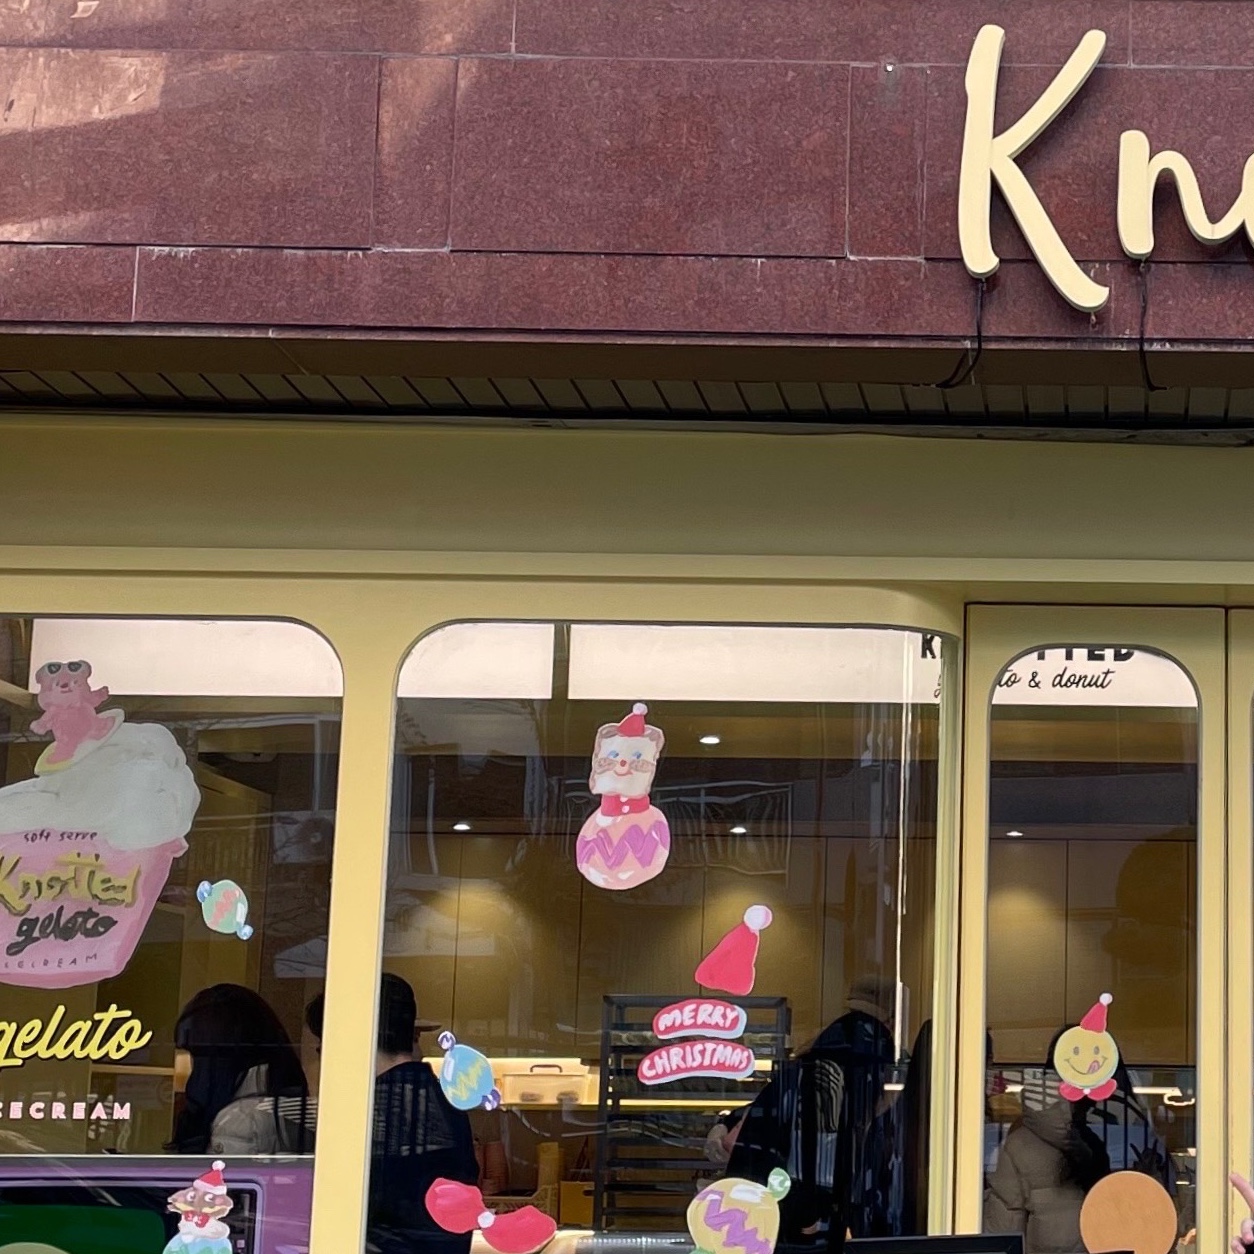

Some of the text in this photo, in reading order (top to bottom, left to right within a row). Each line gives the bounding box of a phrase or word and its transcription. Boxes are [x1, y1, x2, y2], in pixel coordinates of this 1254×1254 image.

[1052, 667, 1119, 689] donut
[60, 831, 98, 841] serve
[6, 905, 118, 956] gelato
[658, 1004, 739, 1031] MERRY
[641, 1042, 749, 1077] CHRISTMAS
[0, 1101, 131, 1120] ECREAM
